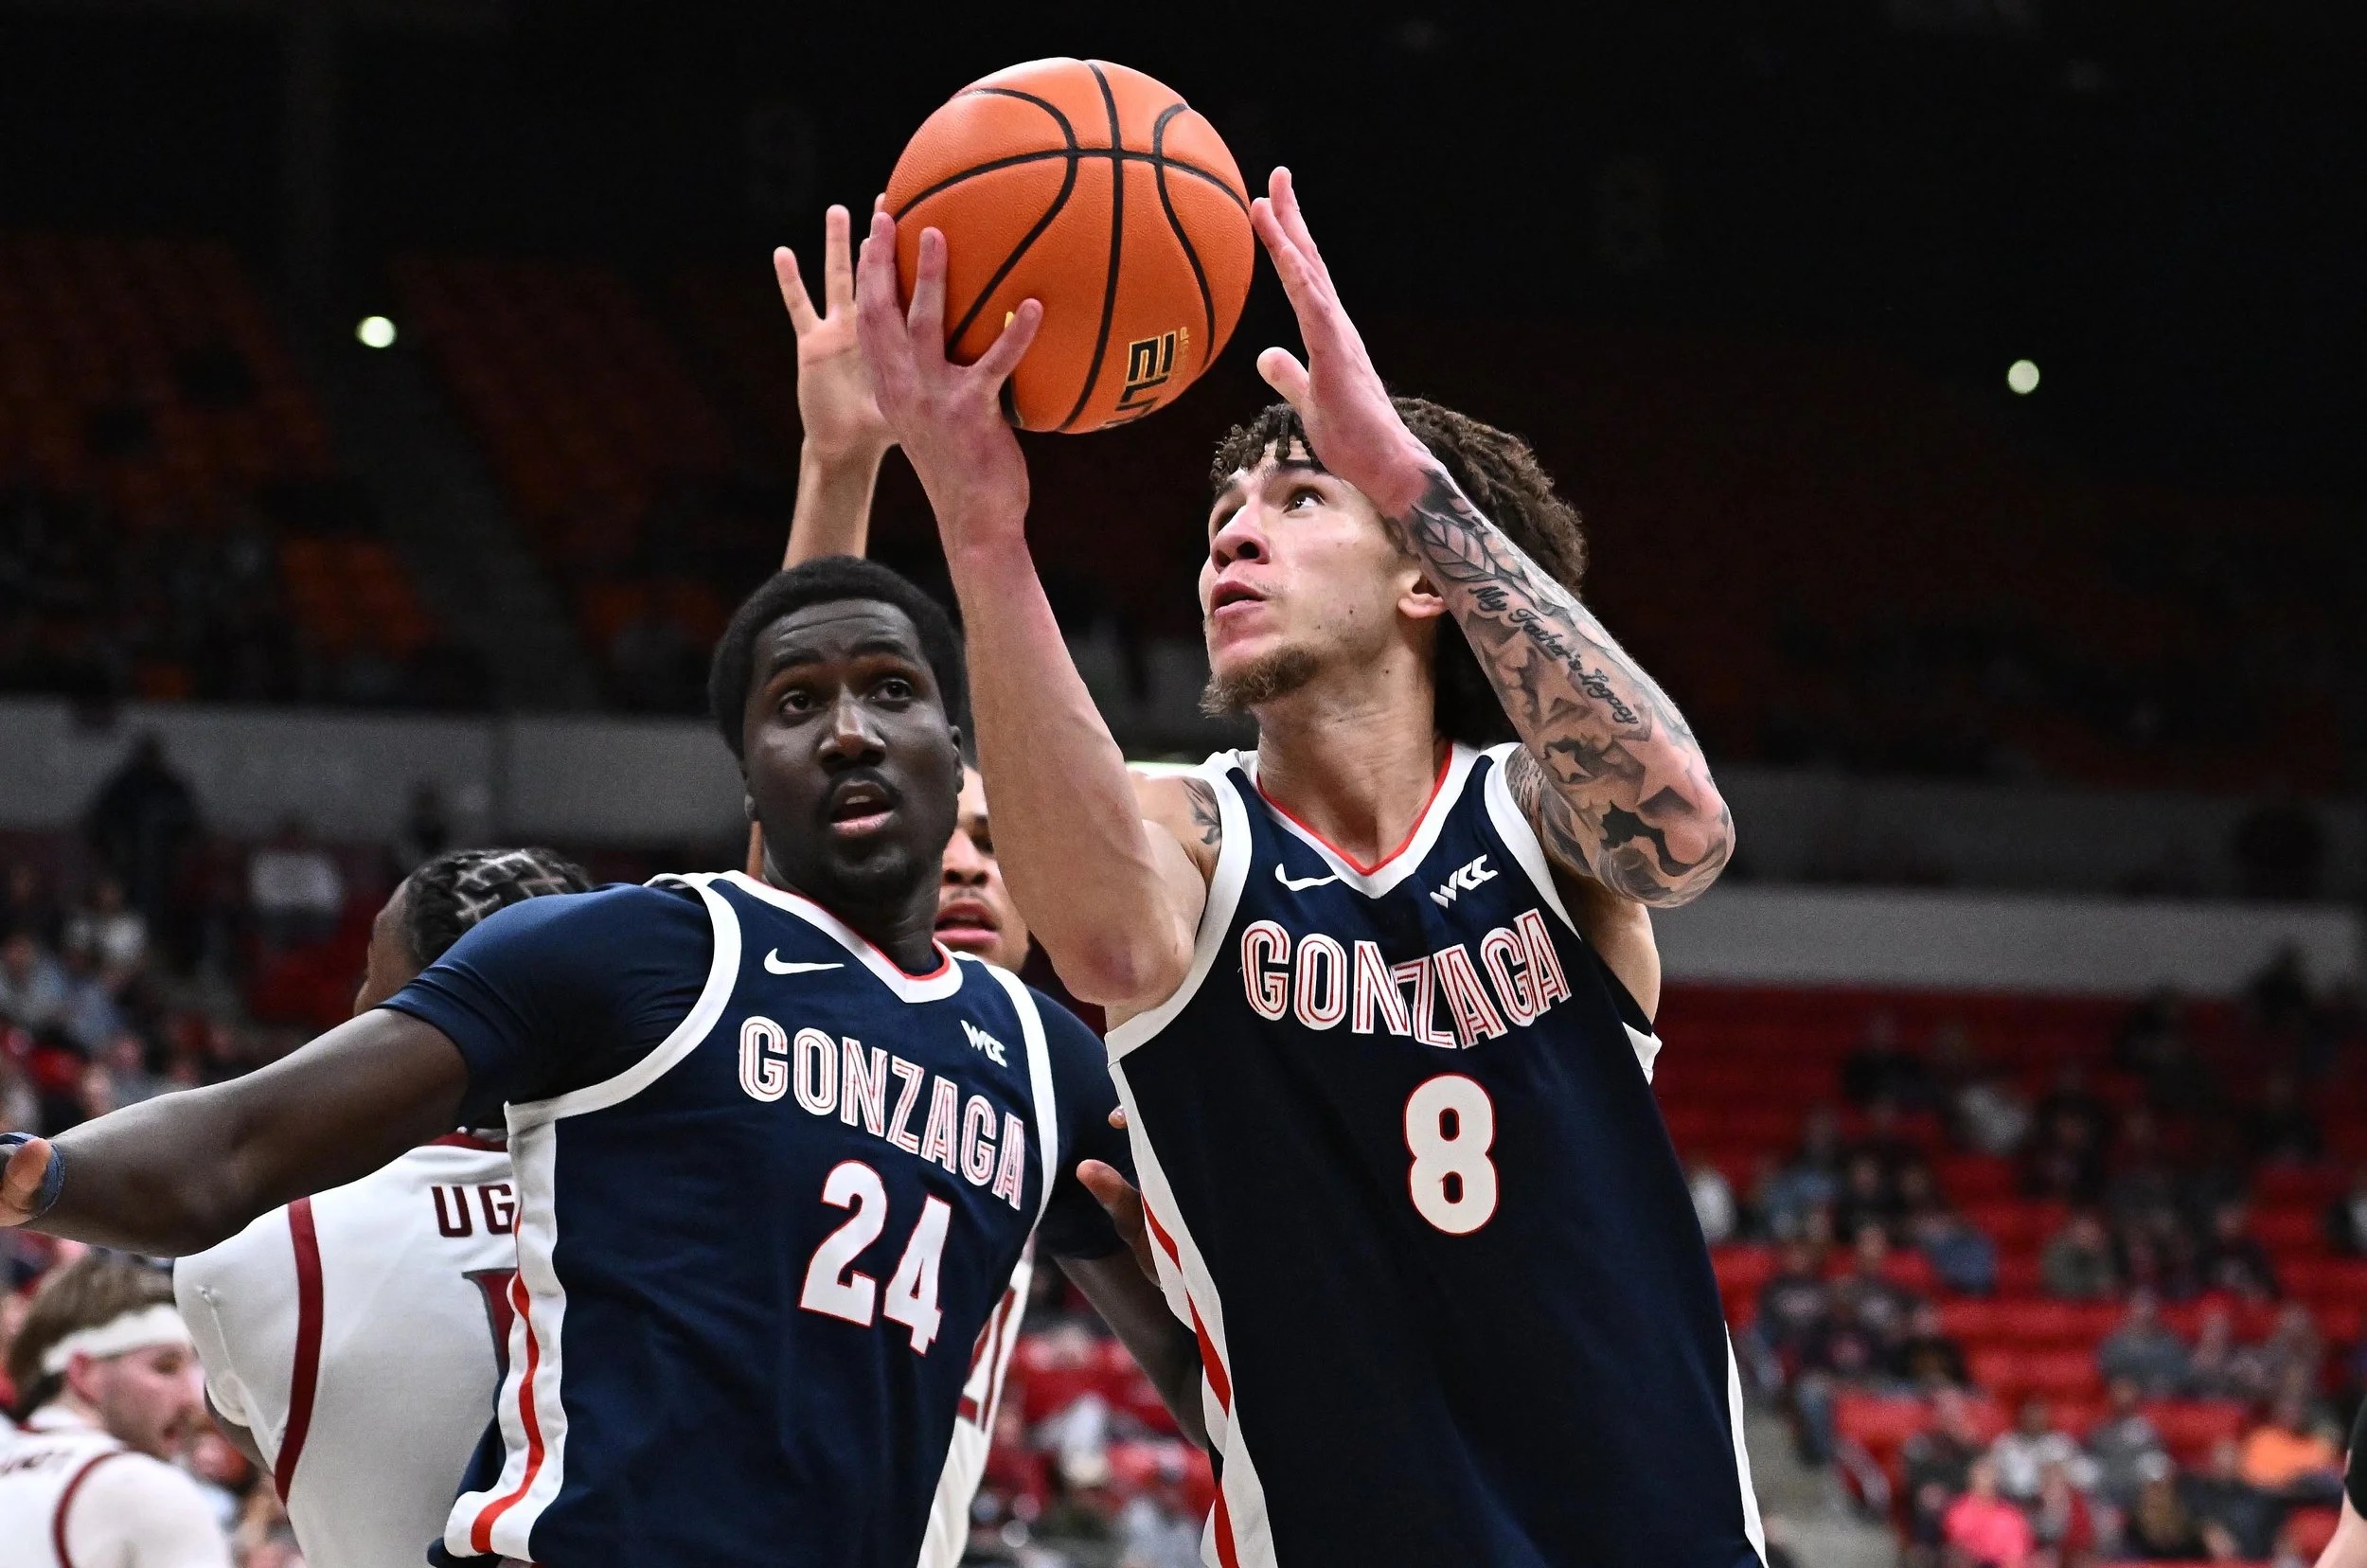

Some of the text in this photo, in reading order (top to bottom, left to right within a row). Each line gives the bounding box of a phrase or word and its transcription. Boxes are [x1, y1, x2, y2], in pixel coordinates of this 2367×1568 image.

[1430, 854, 1499, 908] WCC
[960, 1020, 1007, 1068] WCC
[1240, 908, 1573, 1050] GONZAGA
[739, 1015, 1025, 1211] GONZAGA
[1403, 1072, 1499, 1236] 8
[797, 1159, 952, 1357] 24
